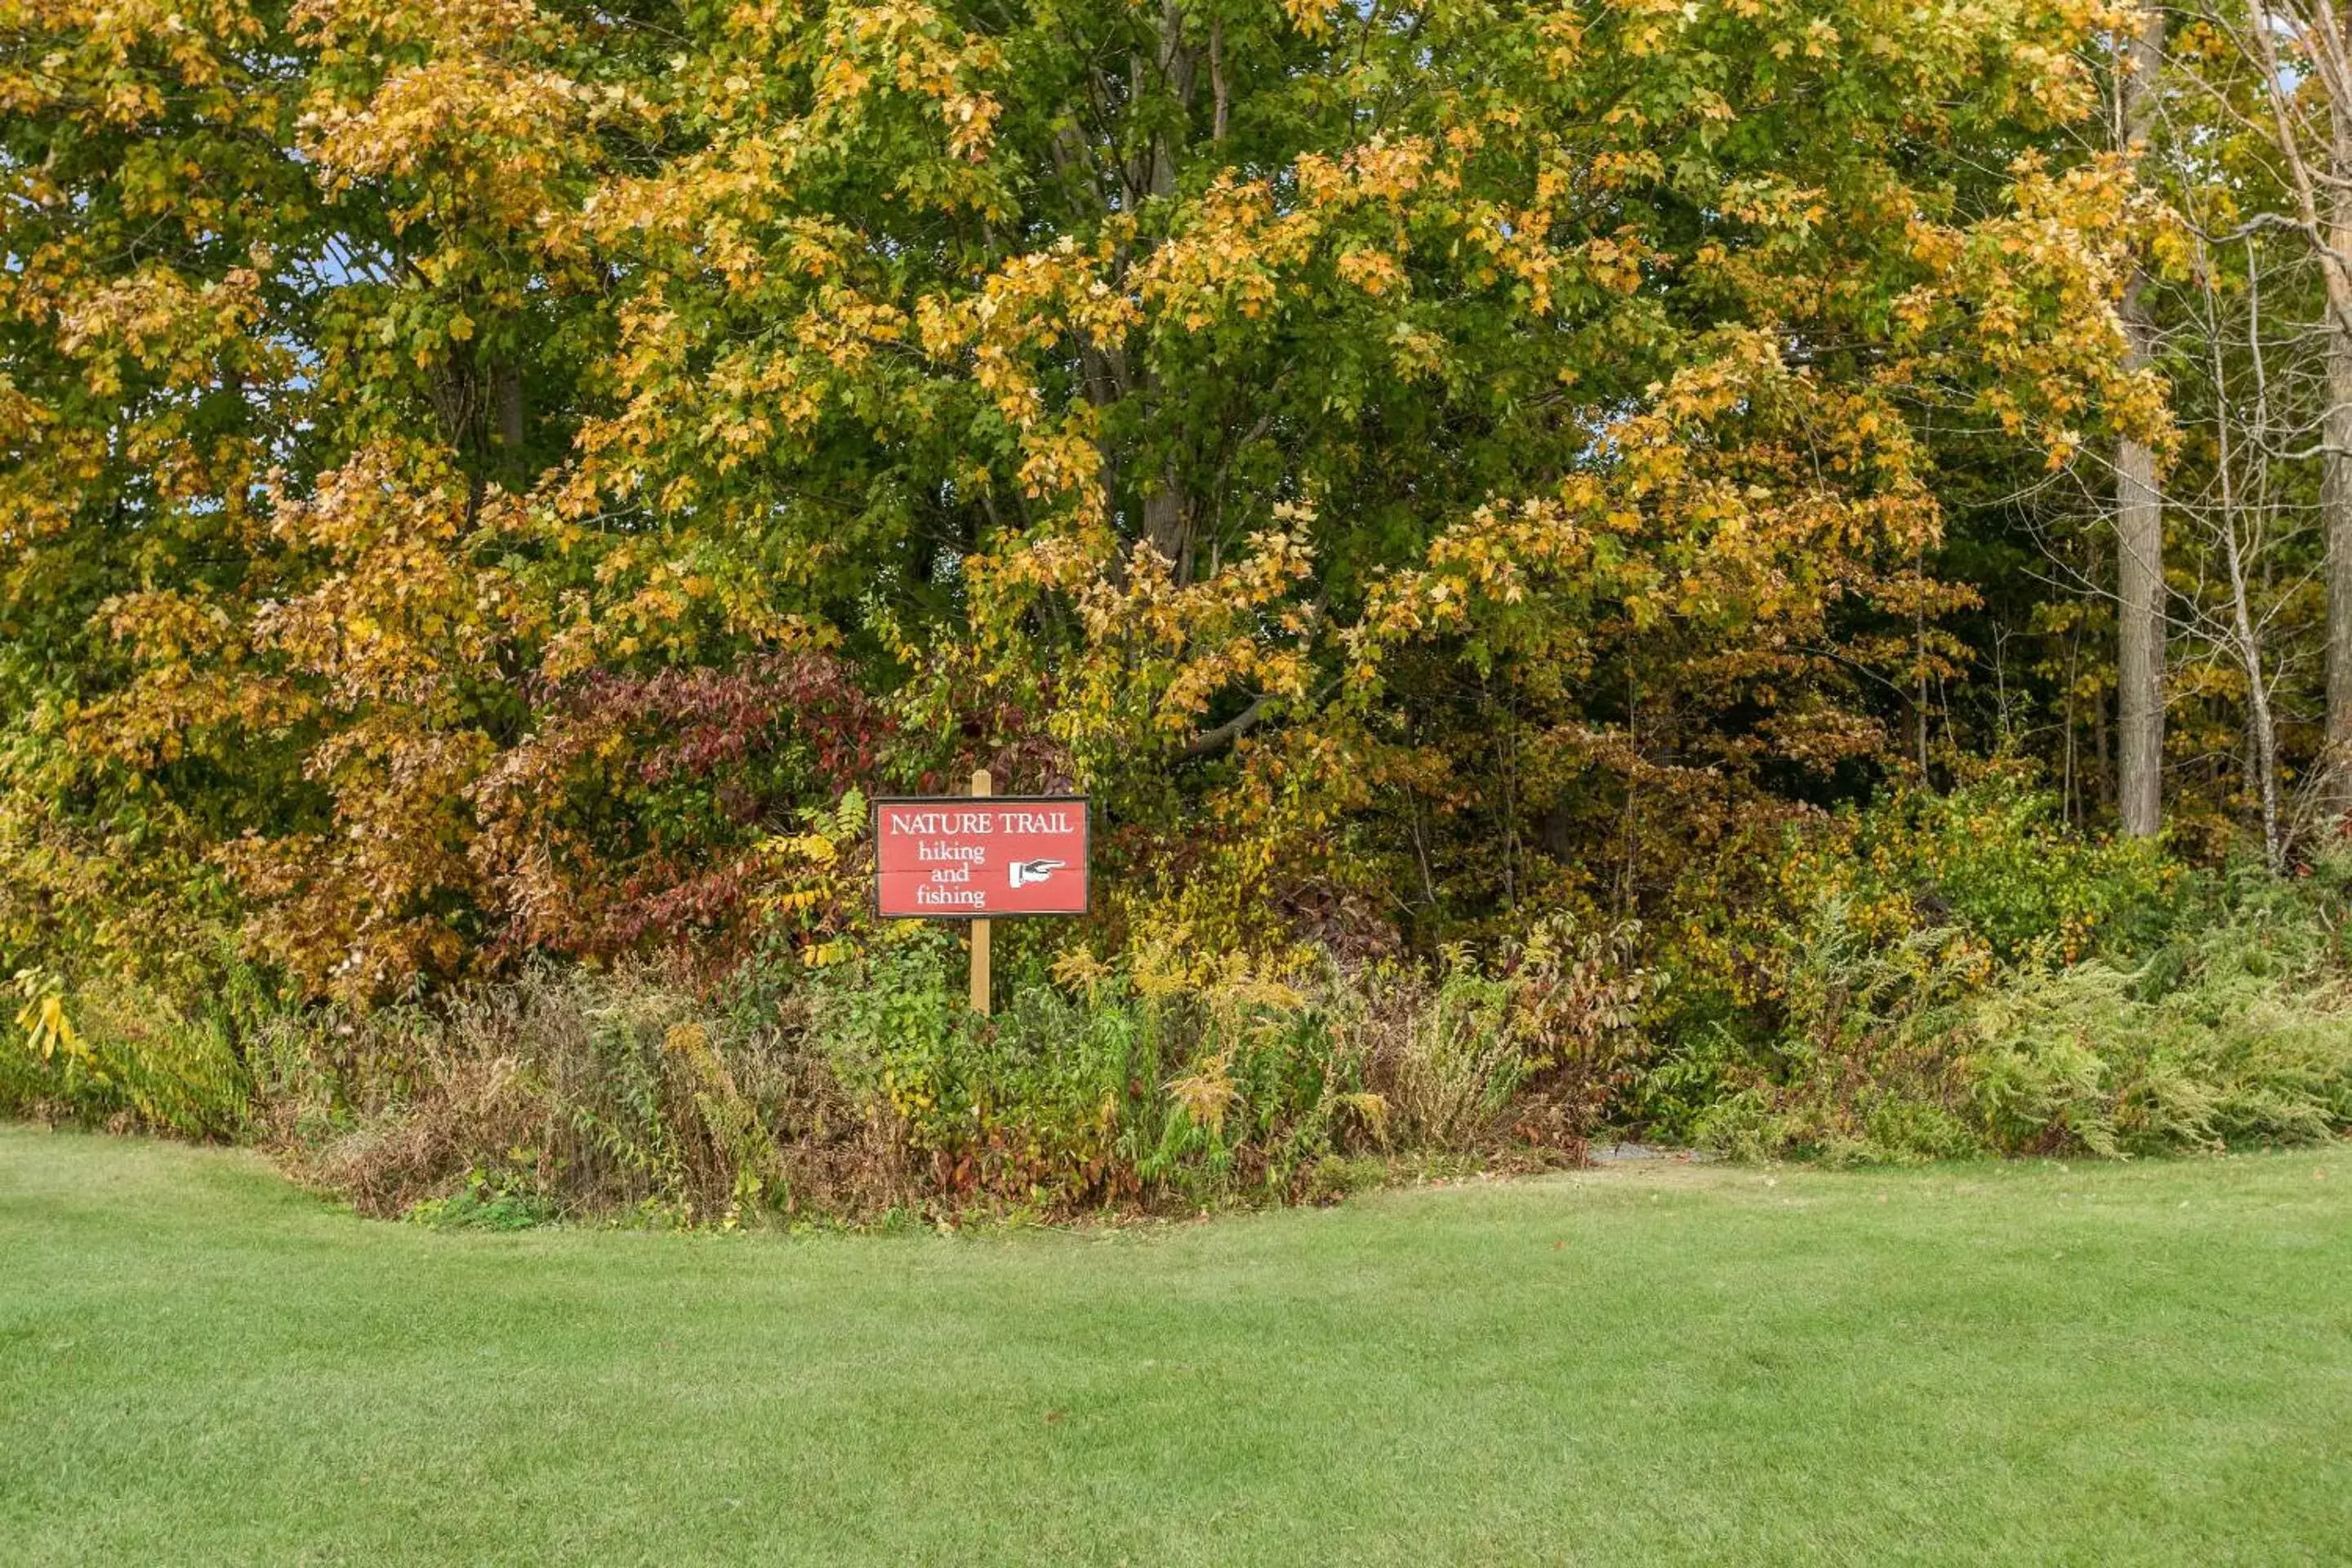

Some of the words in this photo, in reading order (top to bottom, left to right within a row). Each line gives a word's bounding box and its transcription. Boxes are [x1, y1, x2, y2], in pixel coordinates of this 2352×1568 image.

[890, 813, 993, 835] NATURE
[998, 813, 1075, 834] TRAIL
[917, 840, 986, 864] hiking
[930, 862, 970, 883] and
[915, 884, 986, 908] fishing
